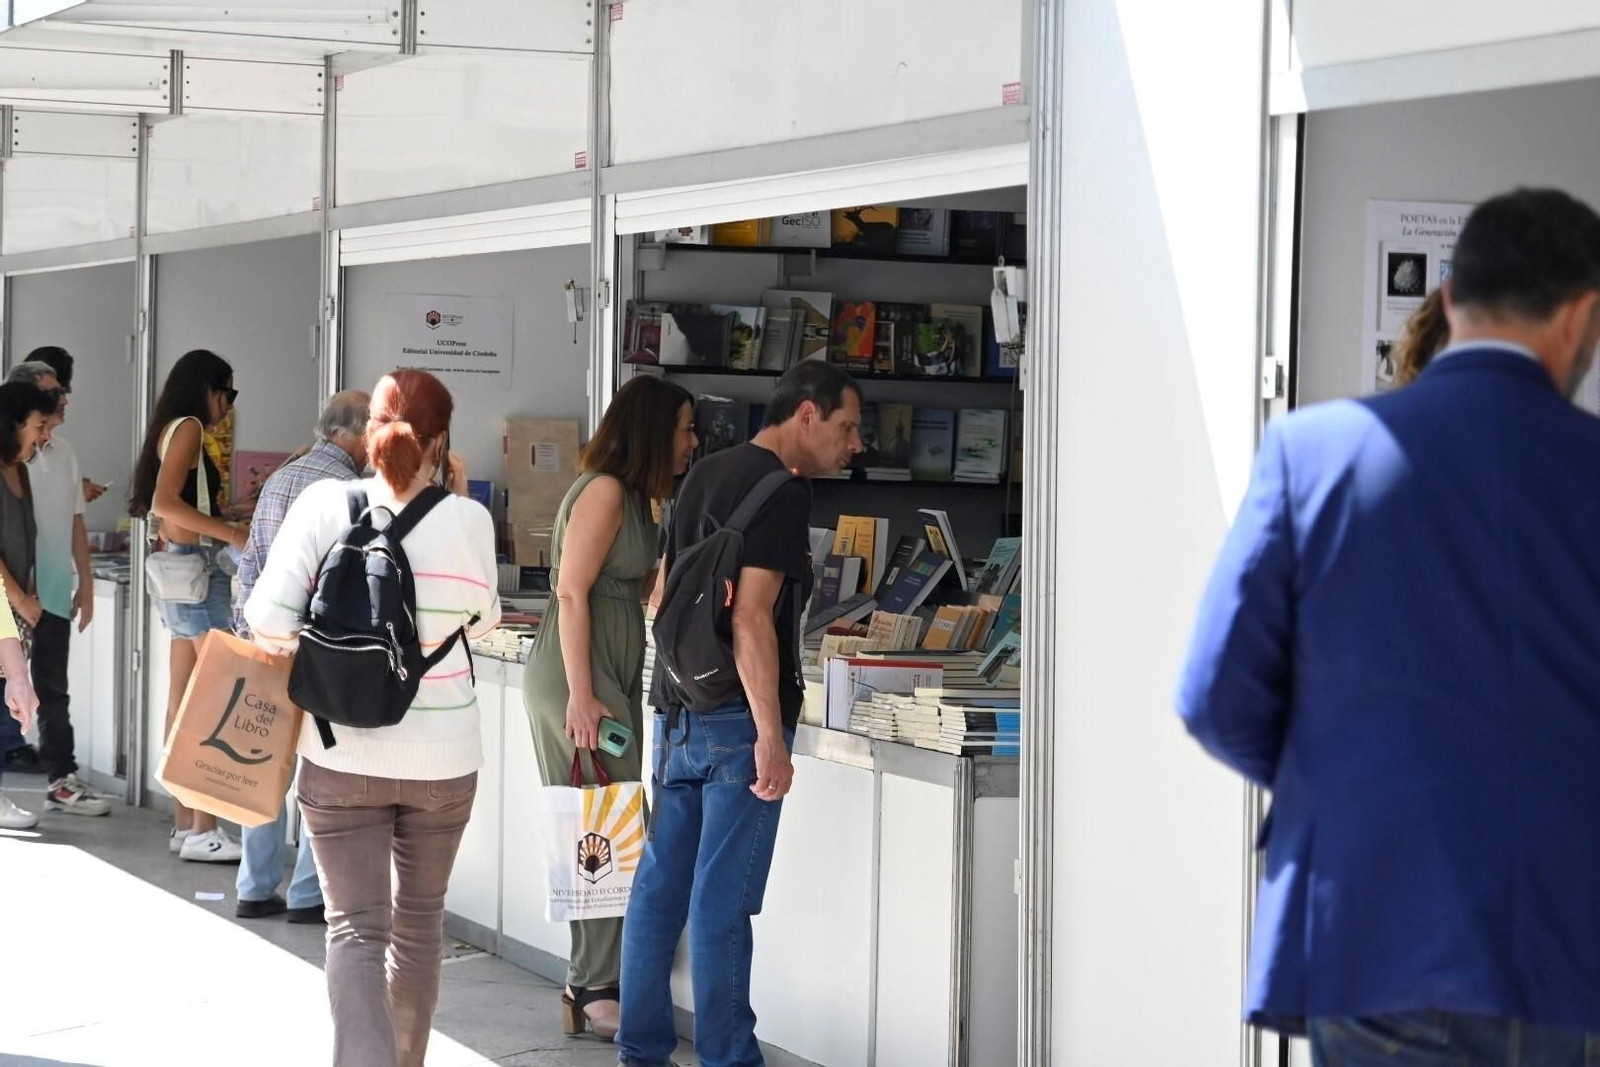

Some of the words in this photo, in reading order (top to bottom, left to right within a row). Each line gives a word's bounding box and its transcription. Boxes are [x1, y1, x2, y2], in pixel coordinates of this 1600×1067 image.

[1400, 213, 1437, 225] POETAS
[1439, 217, 1448, 225] en
[1449, 214, 1457, 225] la
[1402, 227, 1413, 237] La
[402, 347, 428, 355] Editorial
[244, 693, 277, 715] Casa
[234, 715, 269, 738] Libro
[255, 713, 274, 727] del
[195, 759, 226, 777] Gracias
[226, 769, 242, 782] por
[242, 774, 258, 788] leer
